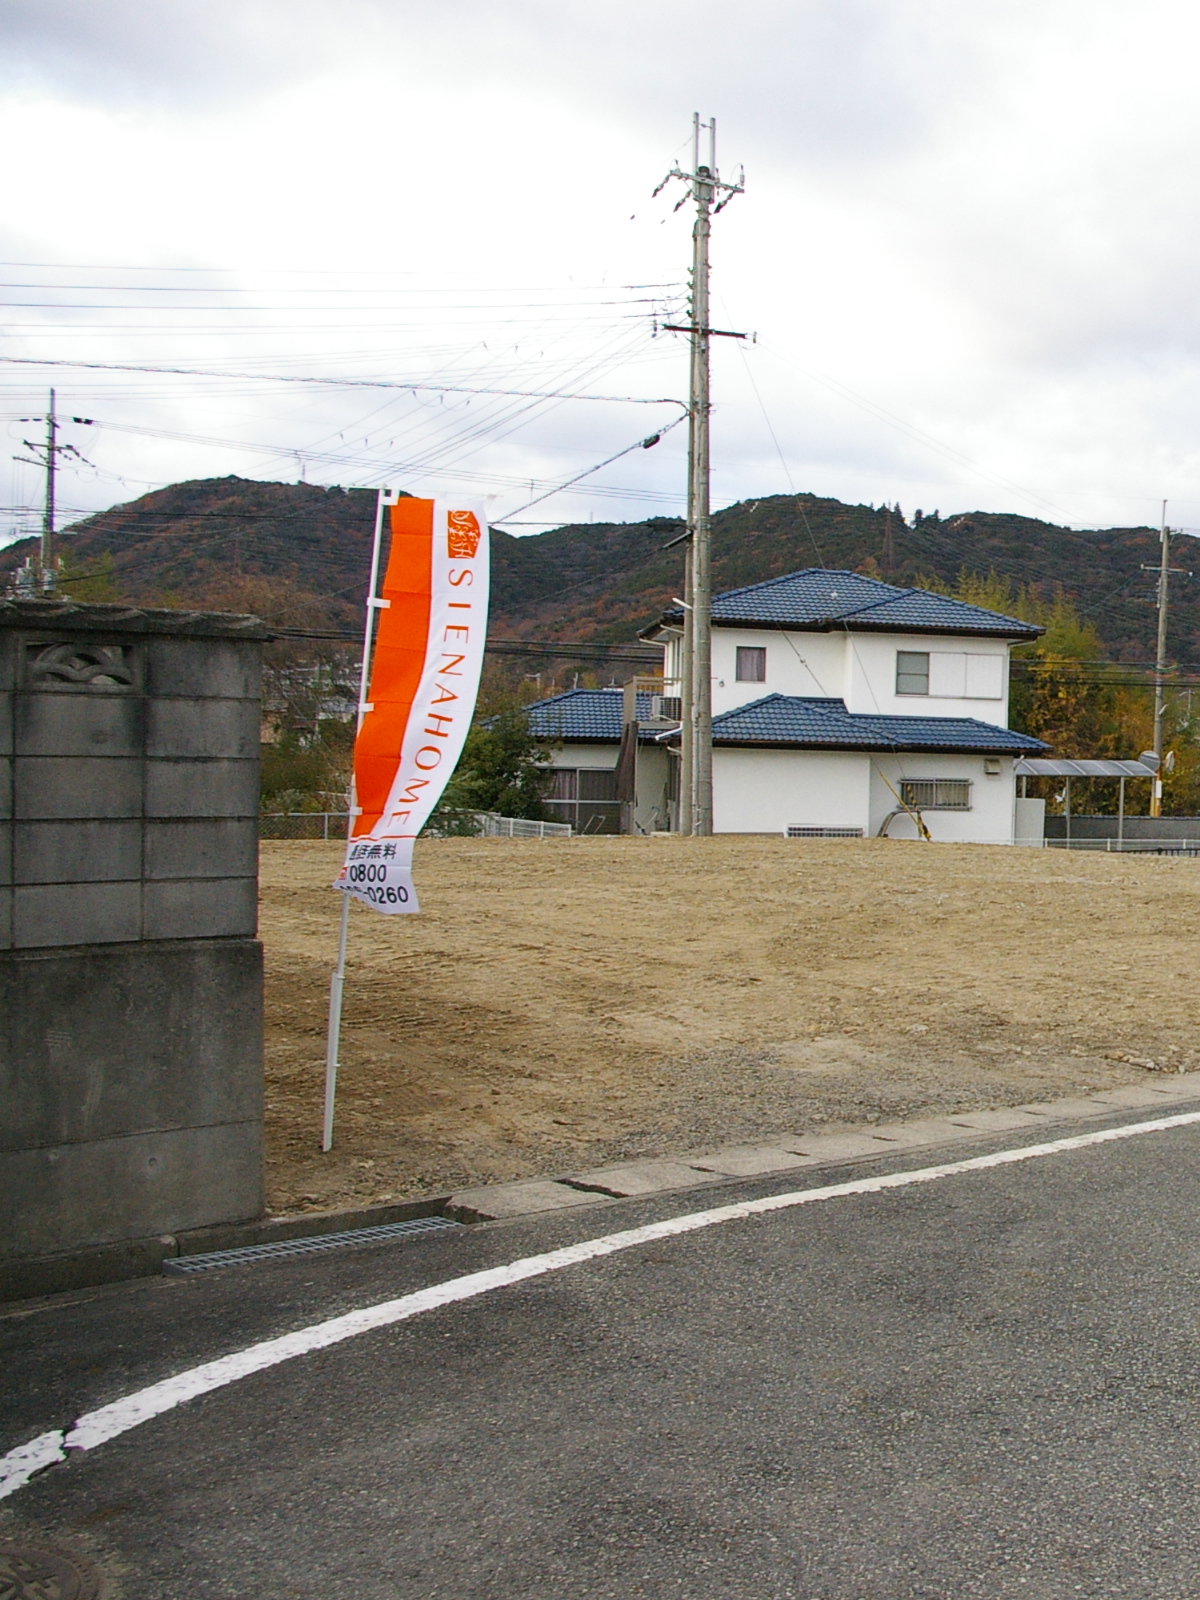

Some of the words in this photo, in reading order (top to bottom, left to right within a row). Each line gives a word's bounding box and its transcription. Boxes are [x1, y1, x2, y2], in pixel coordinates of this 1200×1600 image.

[387, 568, 474, 828] SIENAHOME
[349, 864, 387, 882] 0800
[339, 885, 409, 904] -0260
